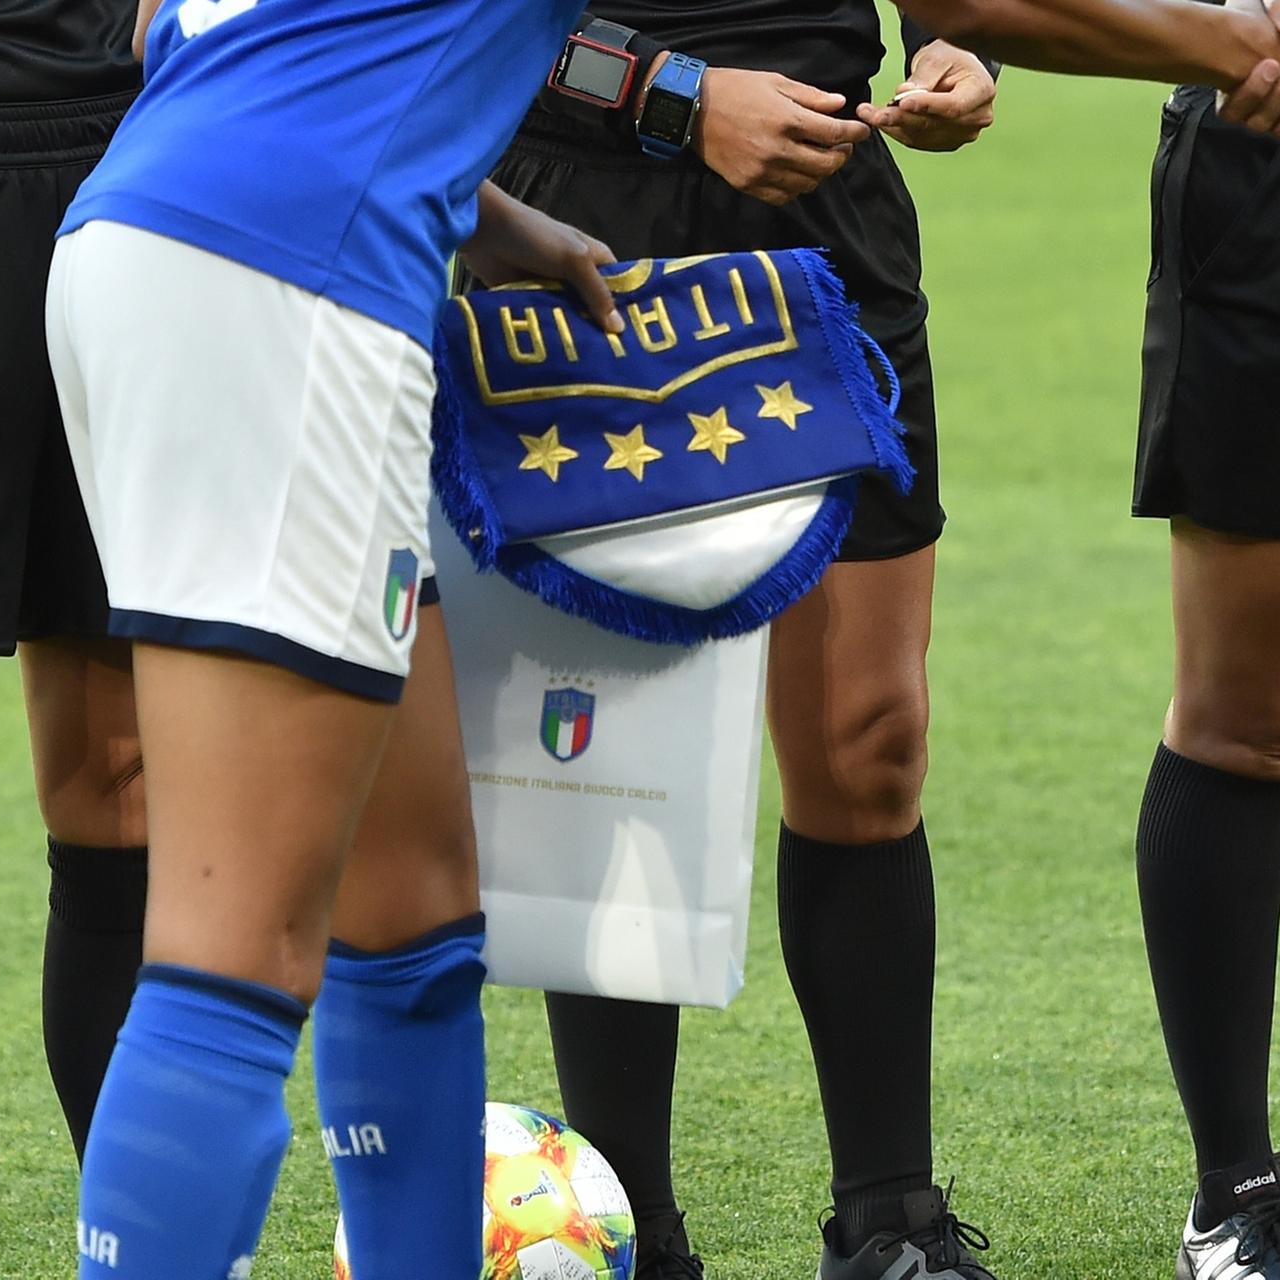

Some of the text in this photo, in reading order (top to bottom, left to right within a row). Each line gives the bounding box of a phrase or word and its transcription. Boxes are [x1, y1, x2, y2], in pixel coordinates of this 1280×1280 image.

[531, 778, 580, 793] ITALIANA
[627, 789, 667, 802] CALCIO
[321, 1123, 386, 1159] ALIA
[77, 1220, 119, 1268] LIA
